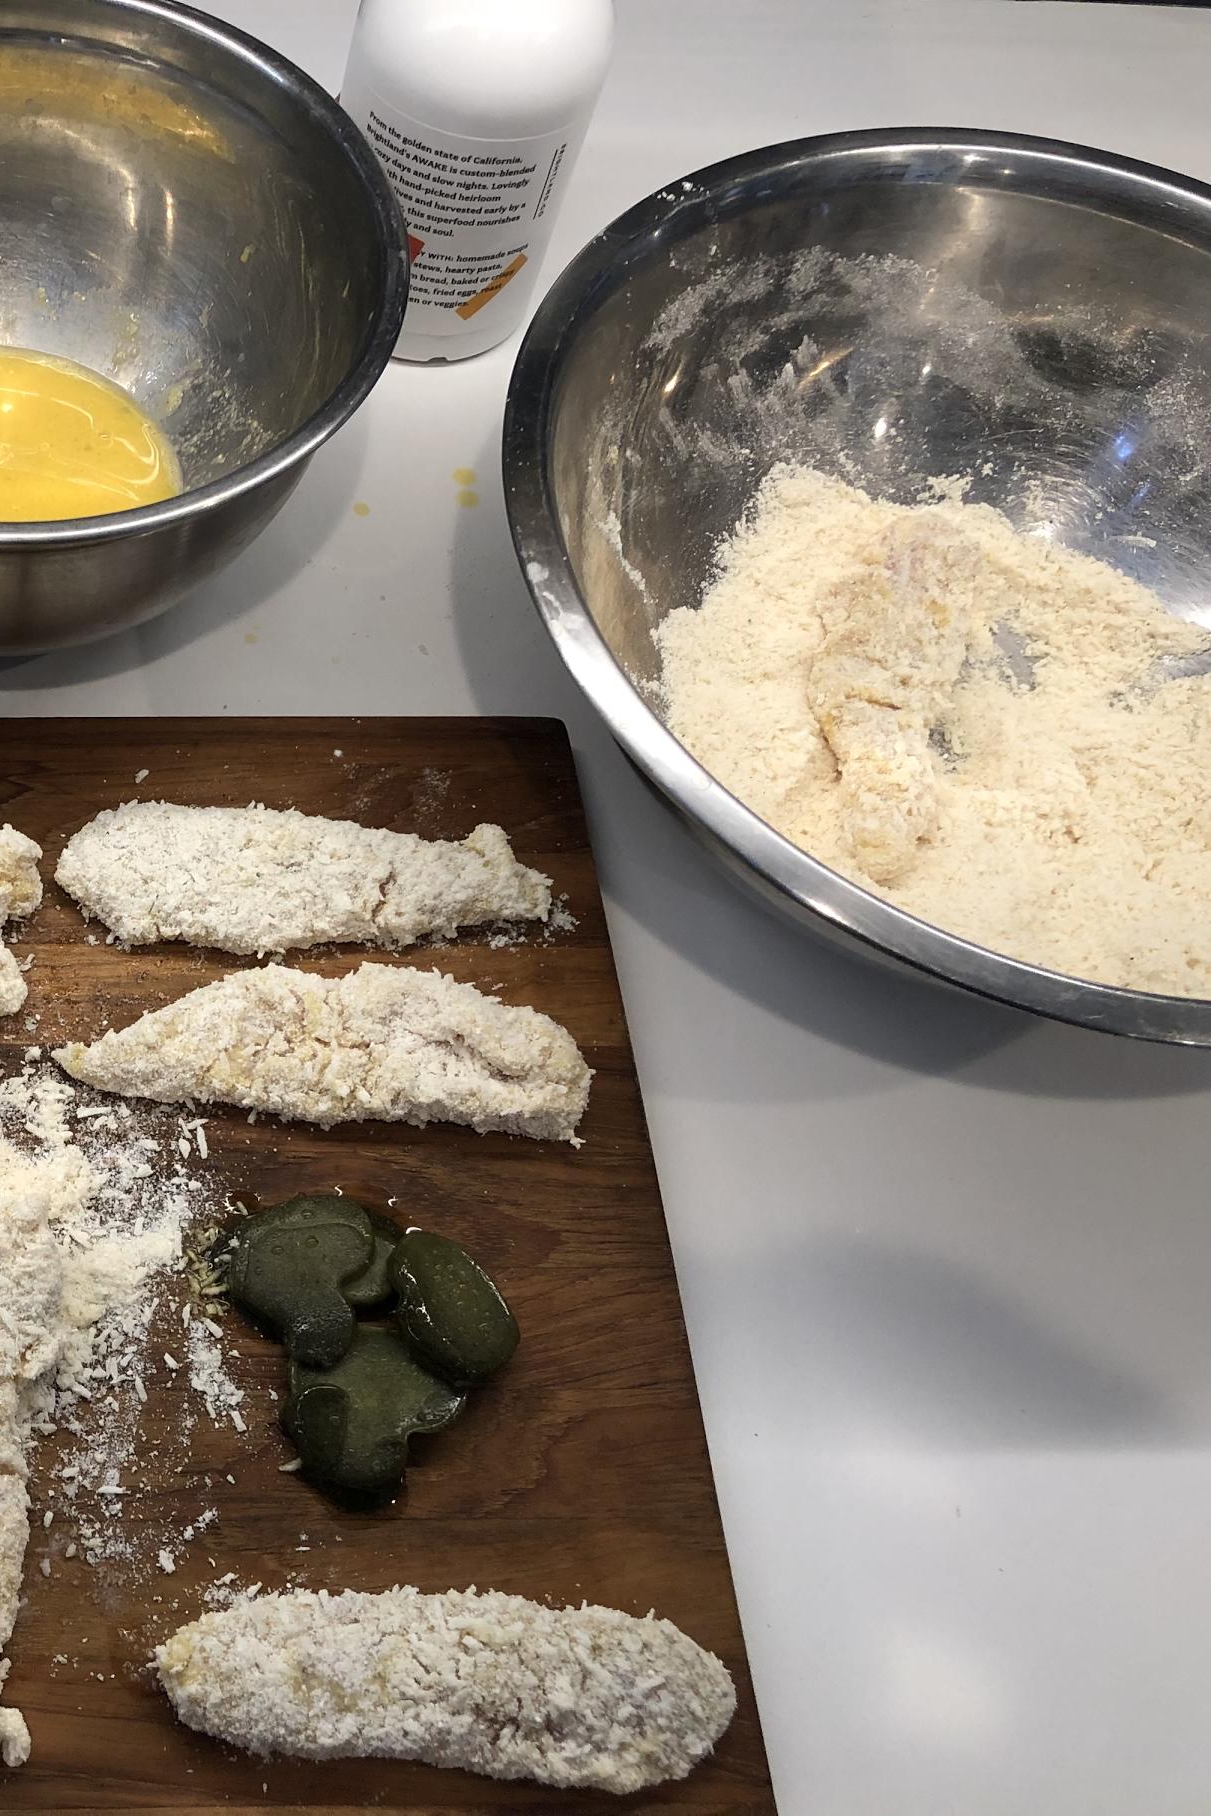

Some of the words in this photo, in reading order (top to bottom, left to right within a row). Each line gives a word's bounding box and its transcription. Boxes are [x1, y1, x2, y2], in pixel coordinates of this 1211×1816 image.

[369, 111, 387, 130] From
[388, 126, 402, 140] the
[402, 136, 432, 154] golden
[434, 149, 459, 162] state
[461, 155, 473, 163] of
[473, 156, 523, 166] California,
[366, 123, 411, 160] Brightland's
[411, 154, 448, 172] AWAKE
[449, 166, 457, 174] is
[459, 164, 537, 178] custom-blended
[392, 159, 411, 174] days
[413, 169, 431, 181] and
[432, 175, 454, 187] slow
[456, 181, 489, 191] nights.
[491, 178, 531, 190] Lovingly
[399, 175, 457, 200] hand-picked
[458, 193, 501, 202] heirloom
[414, 197, 432, 208] and
[434, 202, 482, 215] harvested
[484, 205, 507, 215] early
[508, 204, 520, 212] by
[407, 207, 425, 218] this
[426, 214, 475, 226] superfood
[476, 215, 520, 227] nourishes
[413, 222, 432, 233] and
[432, 229, 455, 237] soul.
[428, 252, 454, 262] WITH:
[456, 251, 505, 262] homemade
[413, 262, 443, 273] stews,
[445, 266, 476, 275] hearty
[477, 264, 503, 274] pasta,
[419, 273, 449, 285] bread,
[451, 276, 478, 285] baked
[433, 287, 455, 296] fried
[457, 290, 479, 298] eggs,
